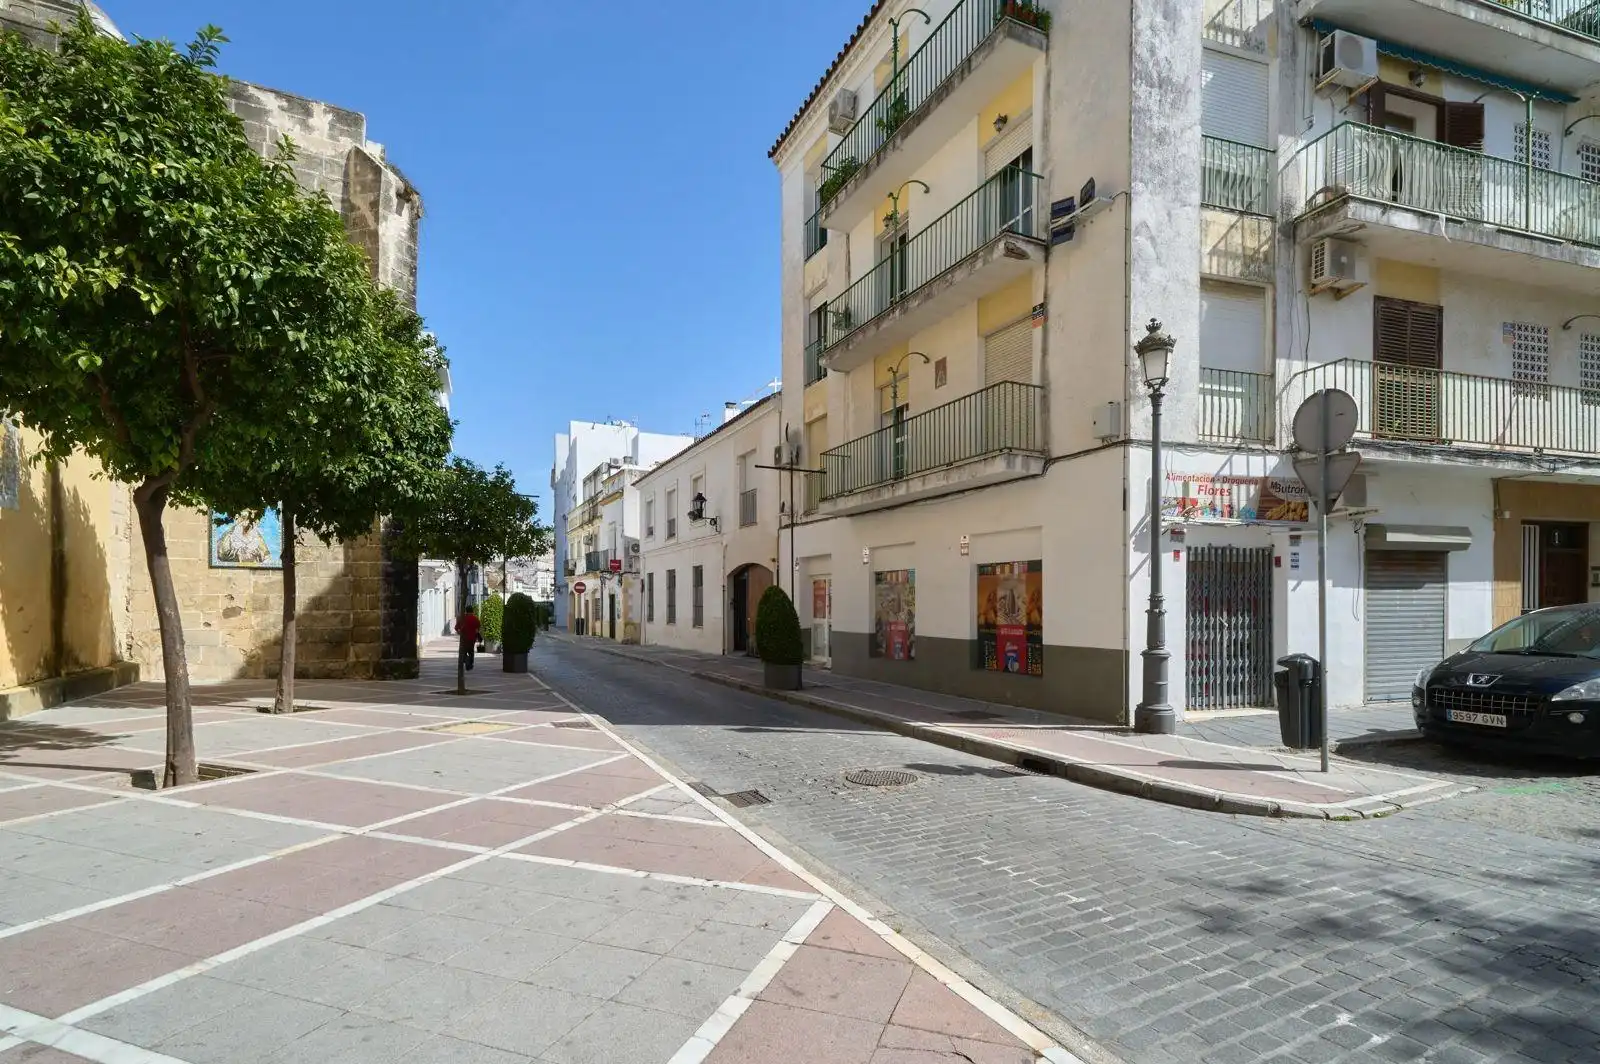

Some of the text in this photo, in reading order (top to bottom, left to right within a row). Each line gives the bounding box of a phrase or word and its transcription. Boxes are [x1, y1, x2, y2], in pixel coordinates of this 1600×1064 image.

[1197, 484, 1231, 496] Flores
[1453, 712, 1504, 725] 9597 GVN
